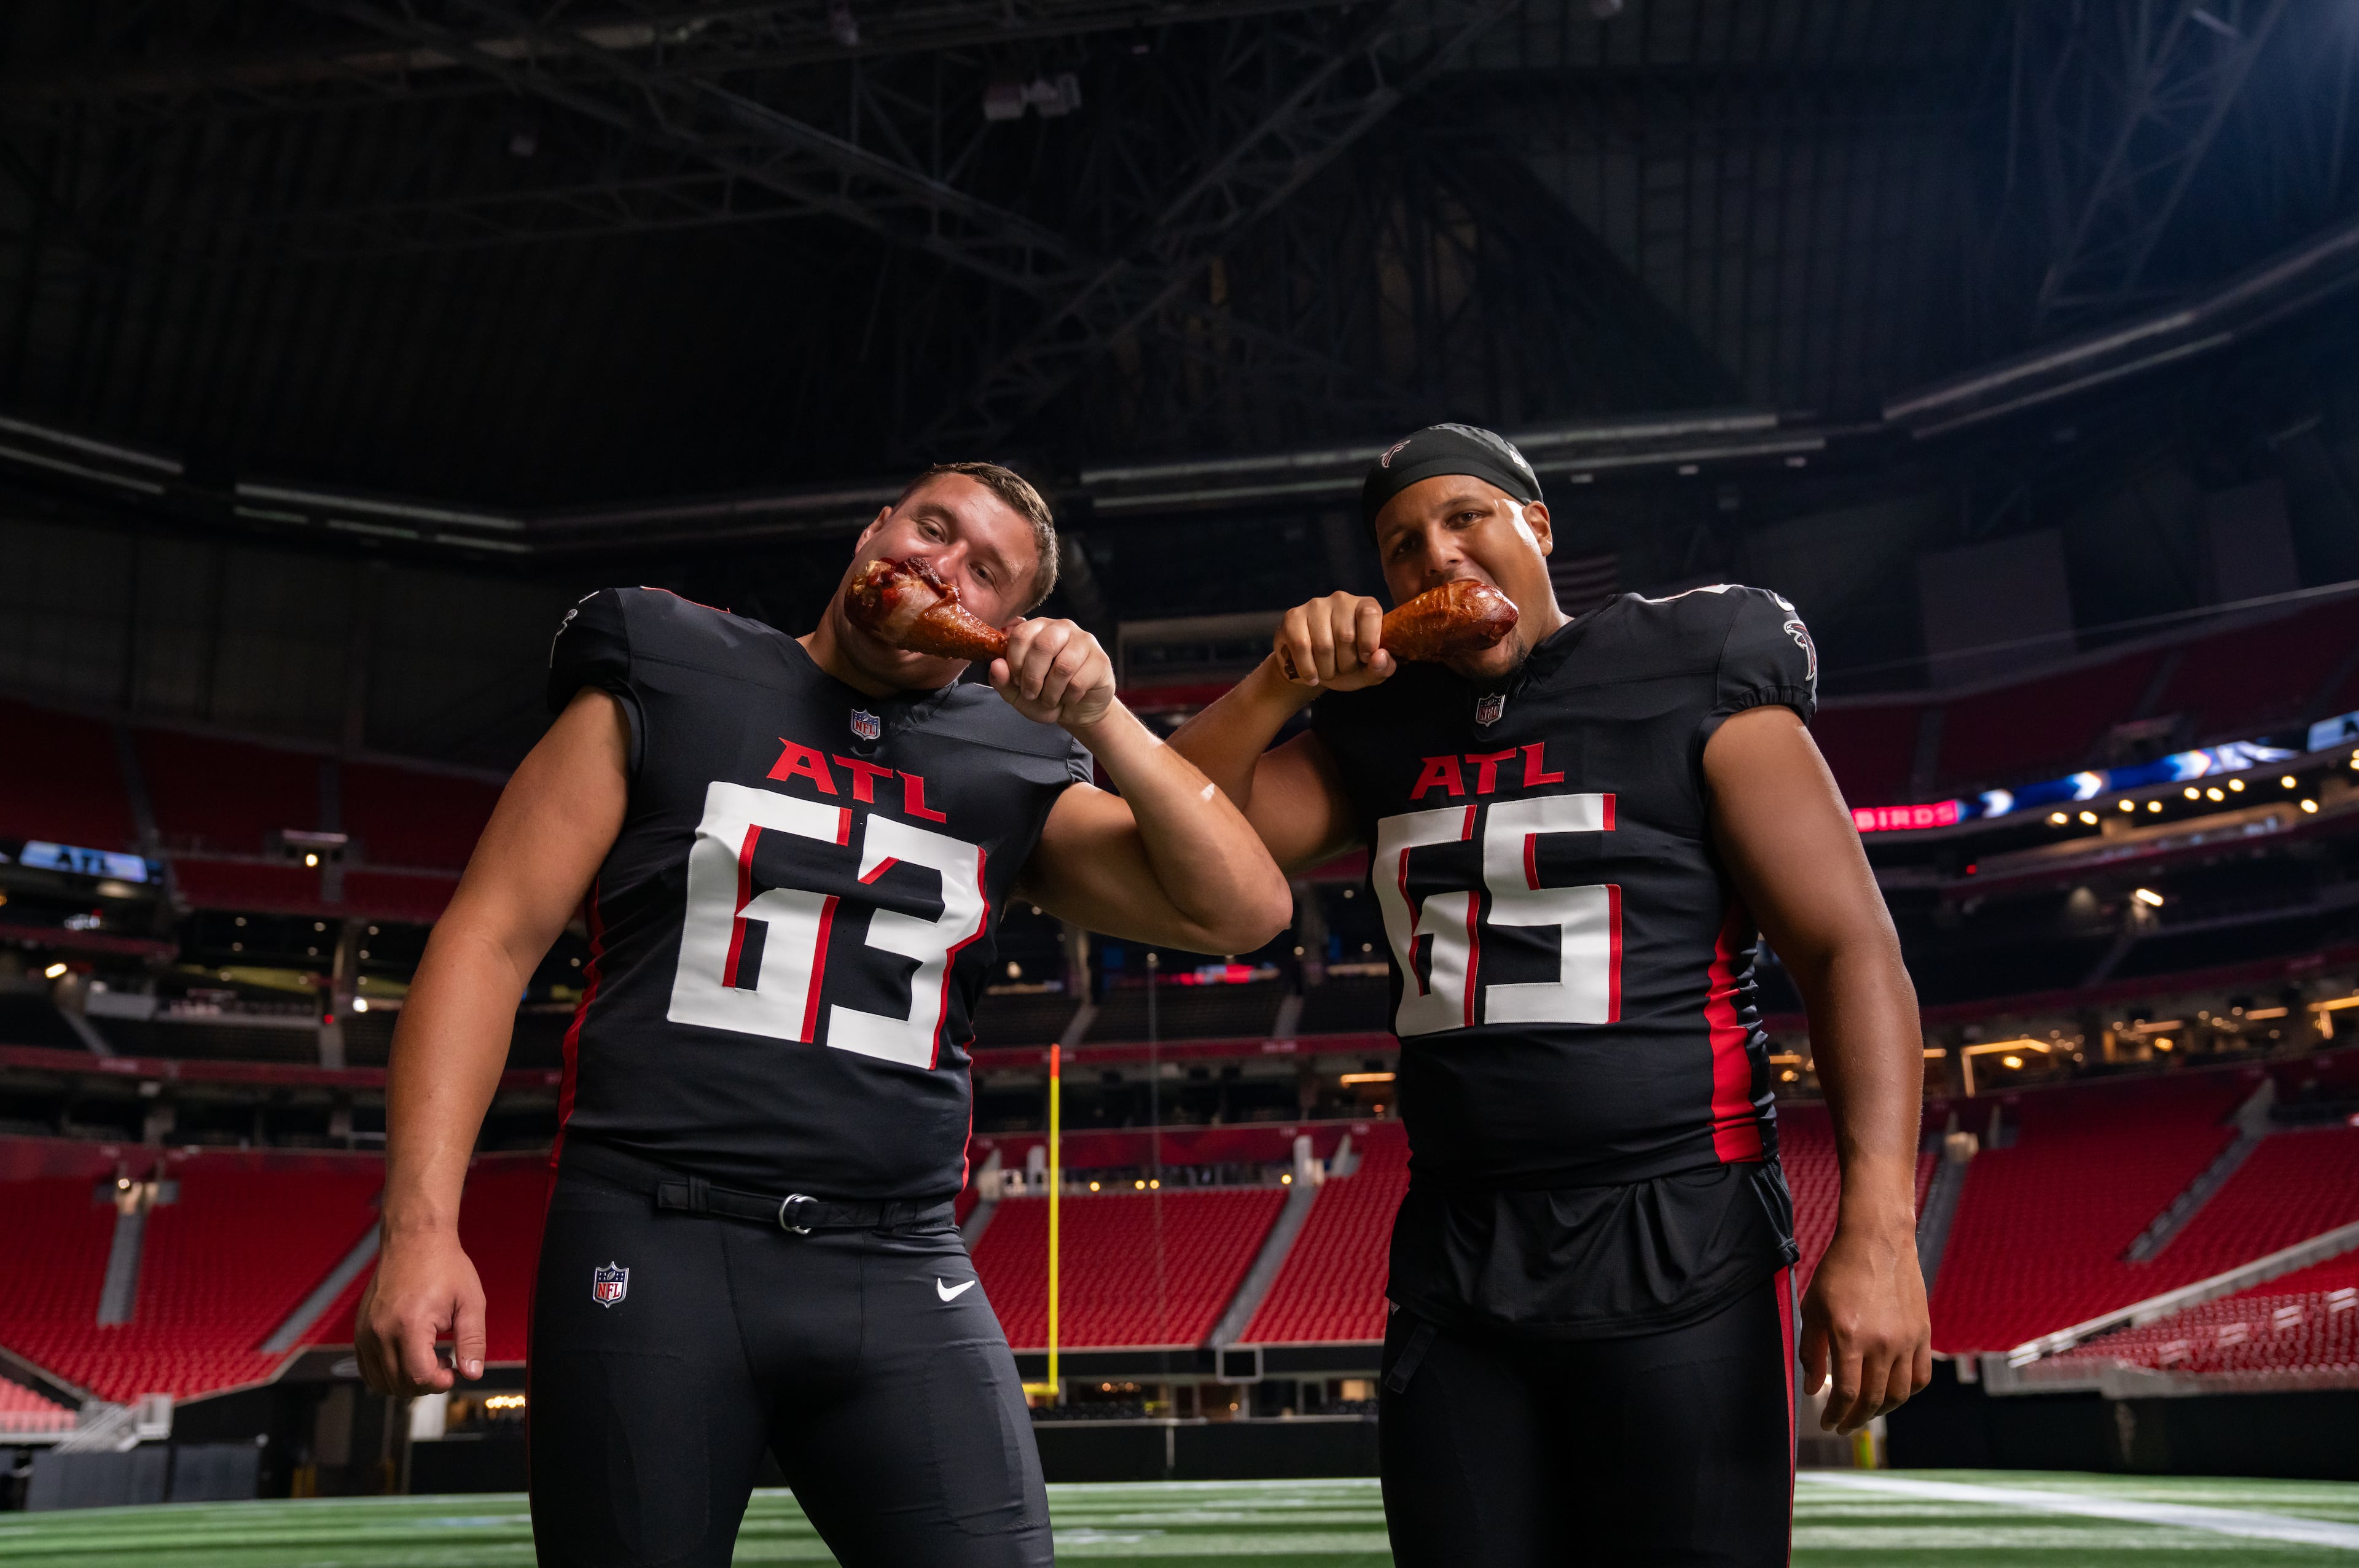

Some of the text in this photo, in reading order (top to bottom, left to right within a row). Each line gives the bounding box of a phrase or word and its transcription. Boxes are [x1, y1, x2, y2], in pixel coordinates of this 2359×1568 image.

[1479, 706, 1498, 720] NFL
[855, 720, 875, 735] NFL
[766, 737, 946, 824] ATL
[1409, 742, 1564, 800] ATL
[1853, 802, 1956, 830] BIRDS
[56, 848, 112, 875] ATL
[667, 781, 990, 1071] 63
[1372, 793, 1622, 1037] 65
[597, 1283, 620, 1300] NFL
